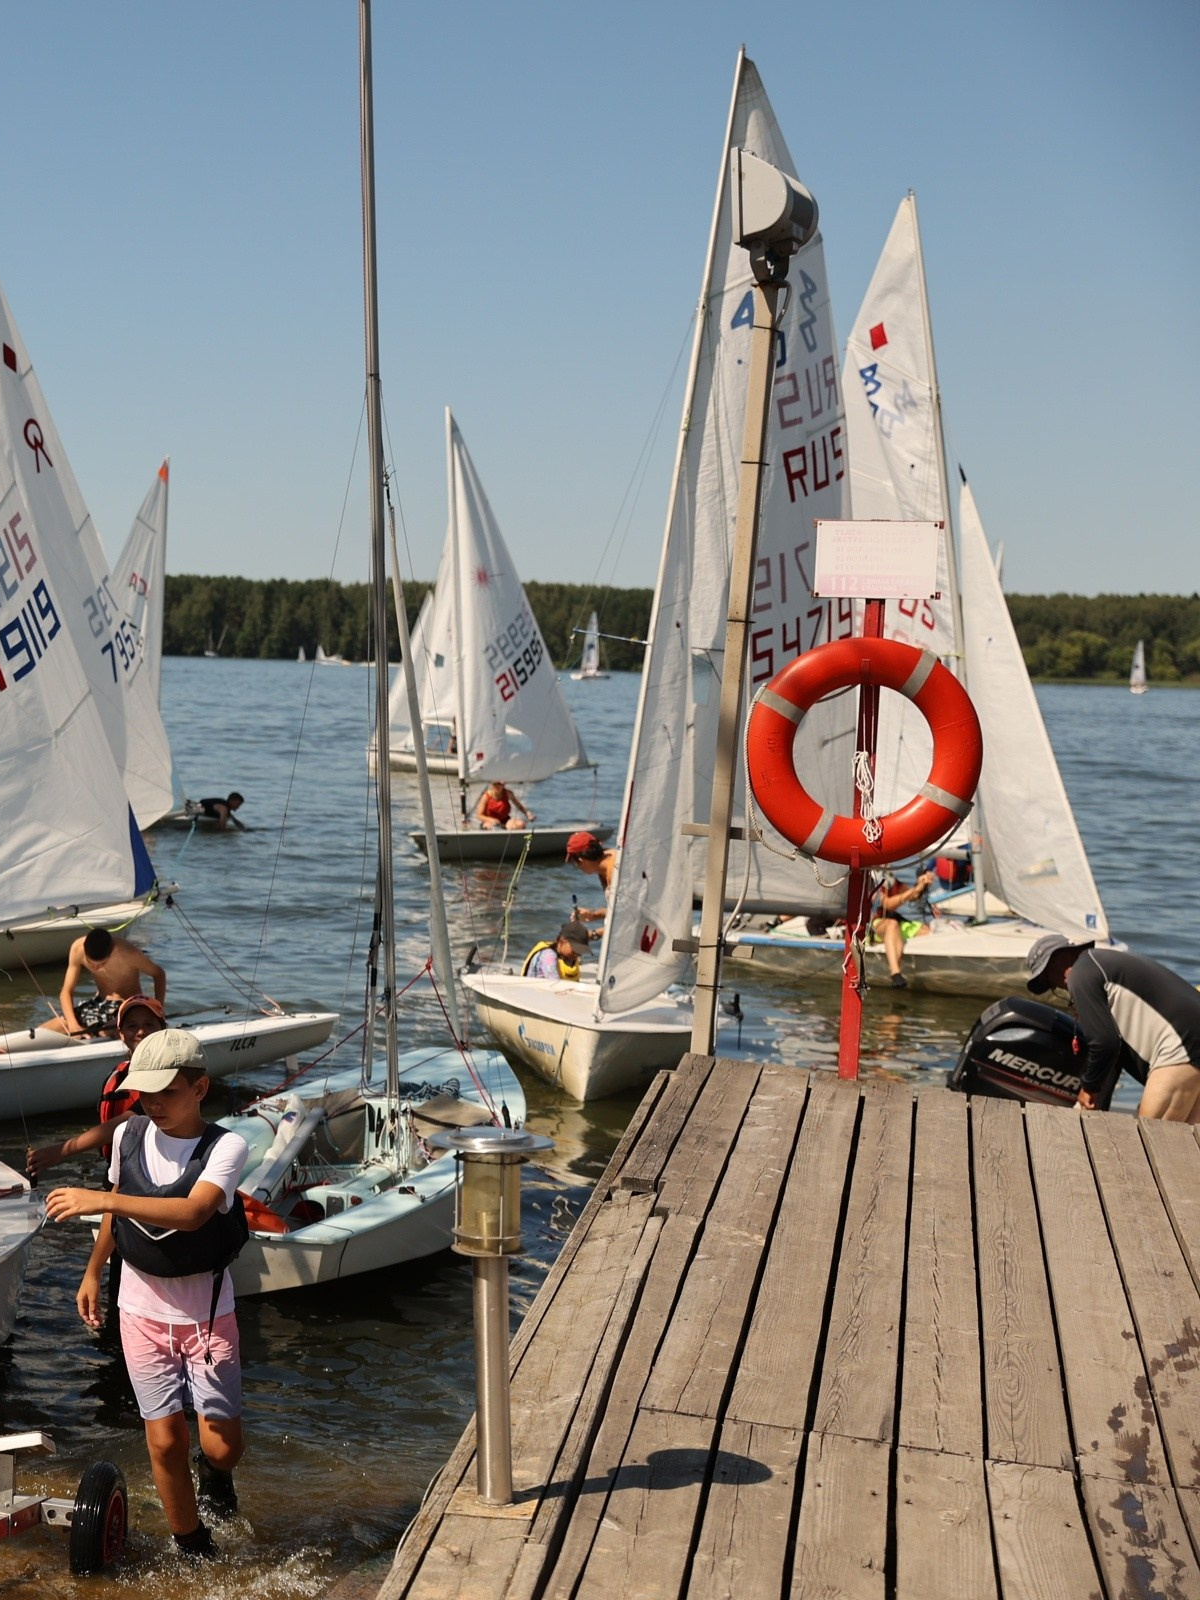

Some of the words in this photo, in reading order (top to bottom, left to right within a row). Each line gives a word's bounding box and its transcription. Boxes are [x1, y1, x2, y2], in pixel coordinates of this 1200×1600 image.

[783, 427, 844, 503] RUS
[230, 1035, 257, 1052] ILCA
[987, 1048, 1082, 1092] MERCUR
